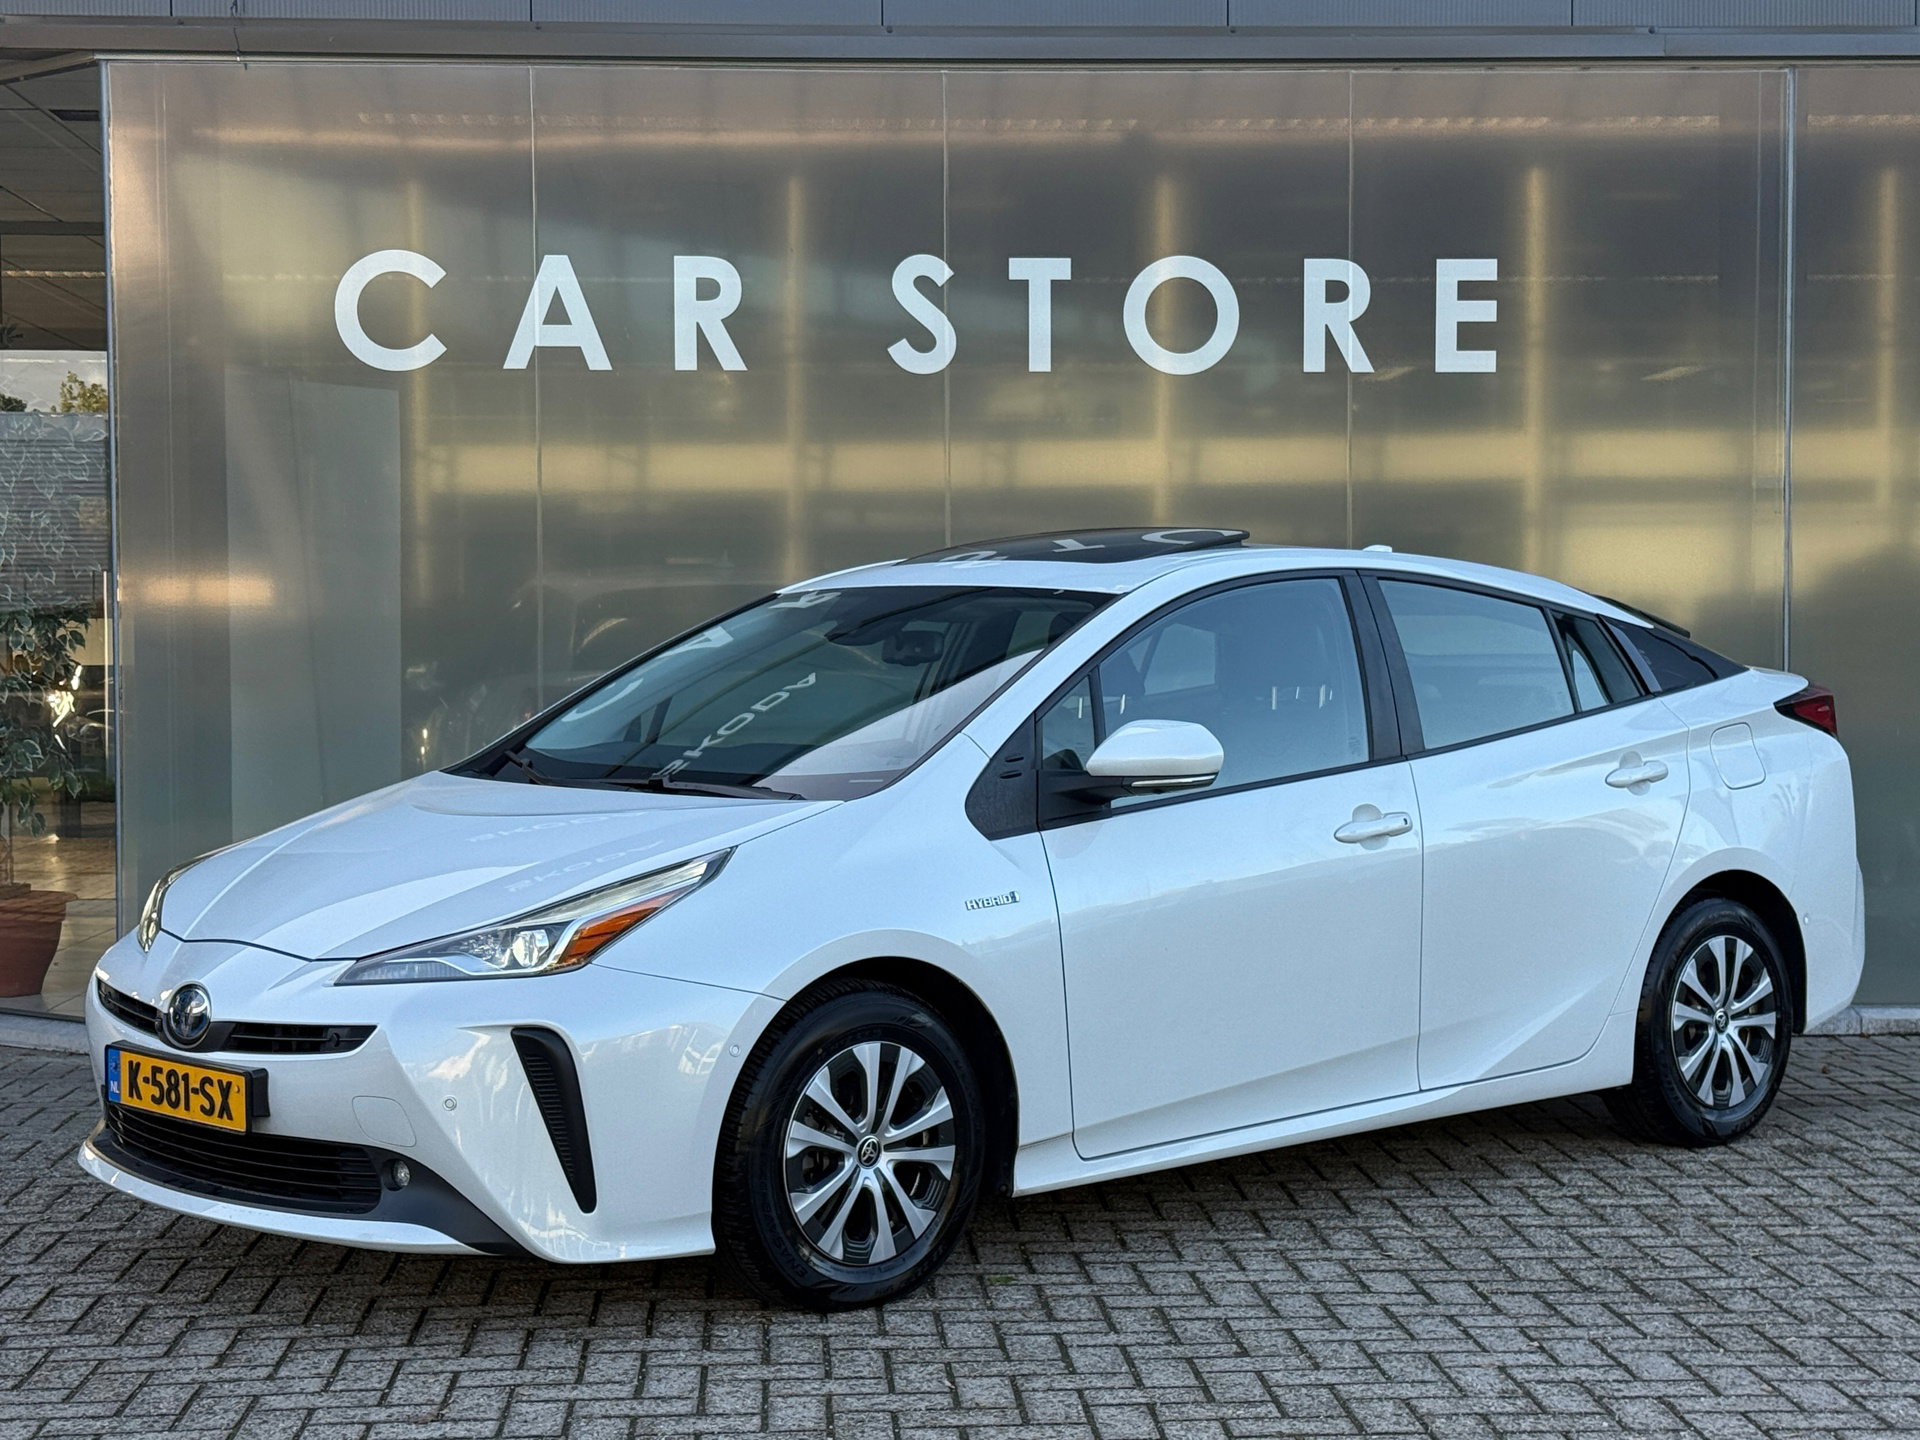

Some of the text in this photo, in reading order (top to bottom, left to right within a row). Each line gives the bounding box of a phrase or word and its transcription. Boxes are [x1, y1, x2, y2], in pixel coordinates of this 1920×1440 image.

[334, 249, 1498, 375] CAR STORE
[965, 894, 1012, 911] HYBRID
[110, 1080, 120, 1094] NL
[128, 1060, 233, 1121] K-581-SX
